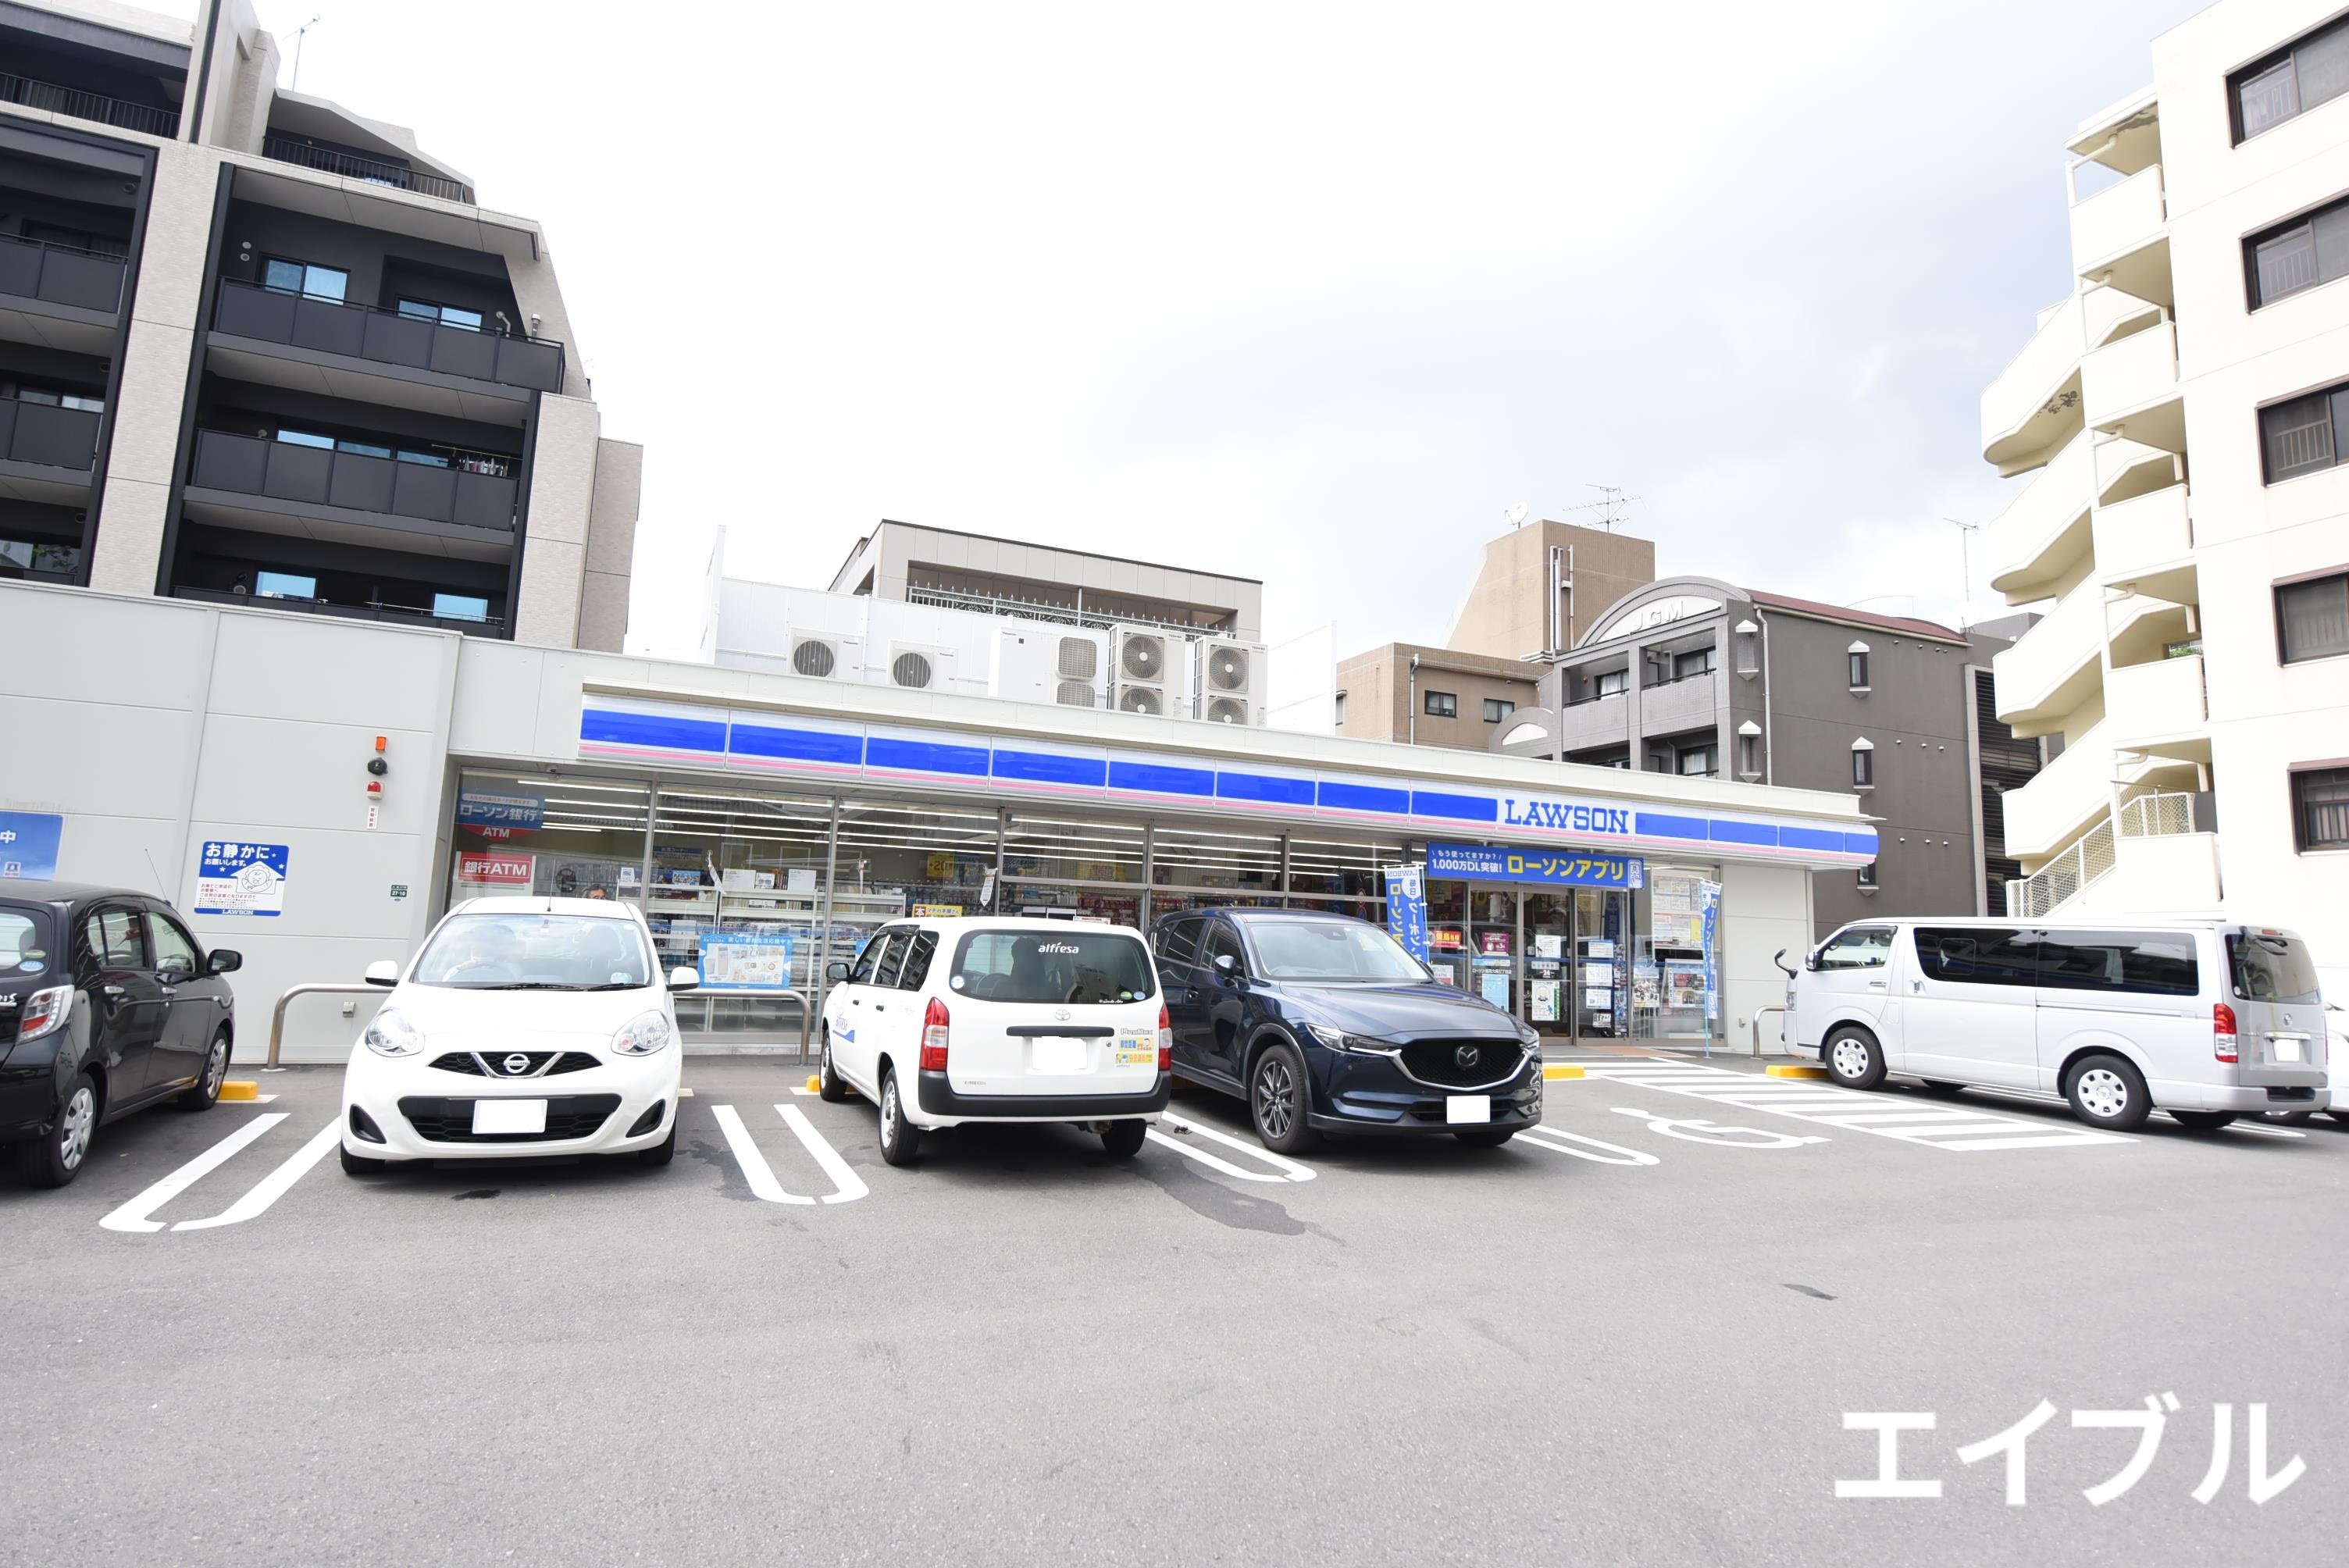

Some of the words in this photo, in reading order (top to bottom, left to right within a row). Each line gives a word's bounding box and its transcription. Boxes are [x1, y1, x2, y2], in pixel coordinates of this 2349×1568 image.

[459, 804, 538, 821] ローソン銀行
[1504, 799, 1629, 834] LAWSON
[482, 827, 511, 839] ATM
[205, 843, 270, 860] お静かに
[463, 861, 527, 876] 銀行ATM
[1506, 855, 1624, 881] ローソンアプリ
[914, 907, 925, 917] 本
[1038, 942, 1079, 954] alfresa
